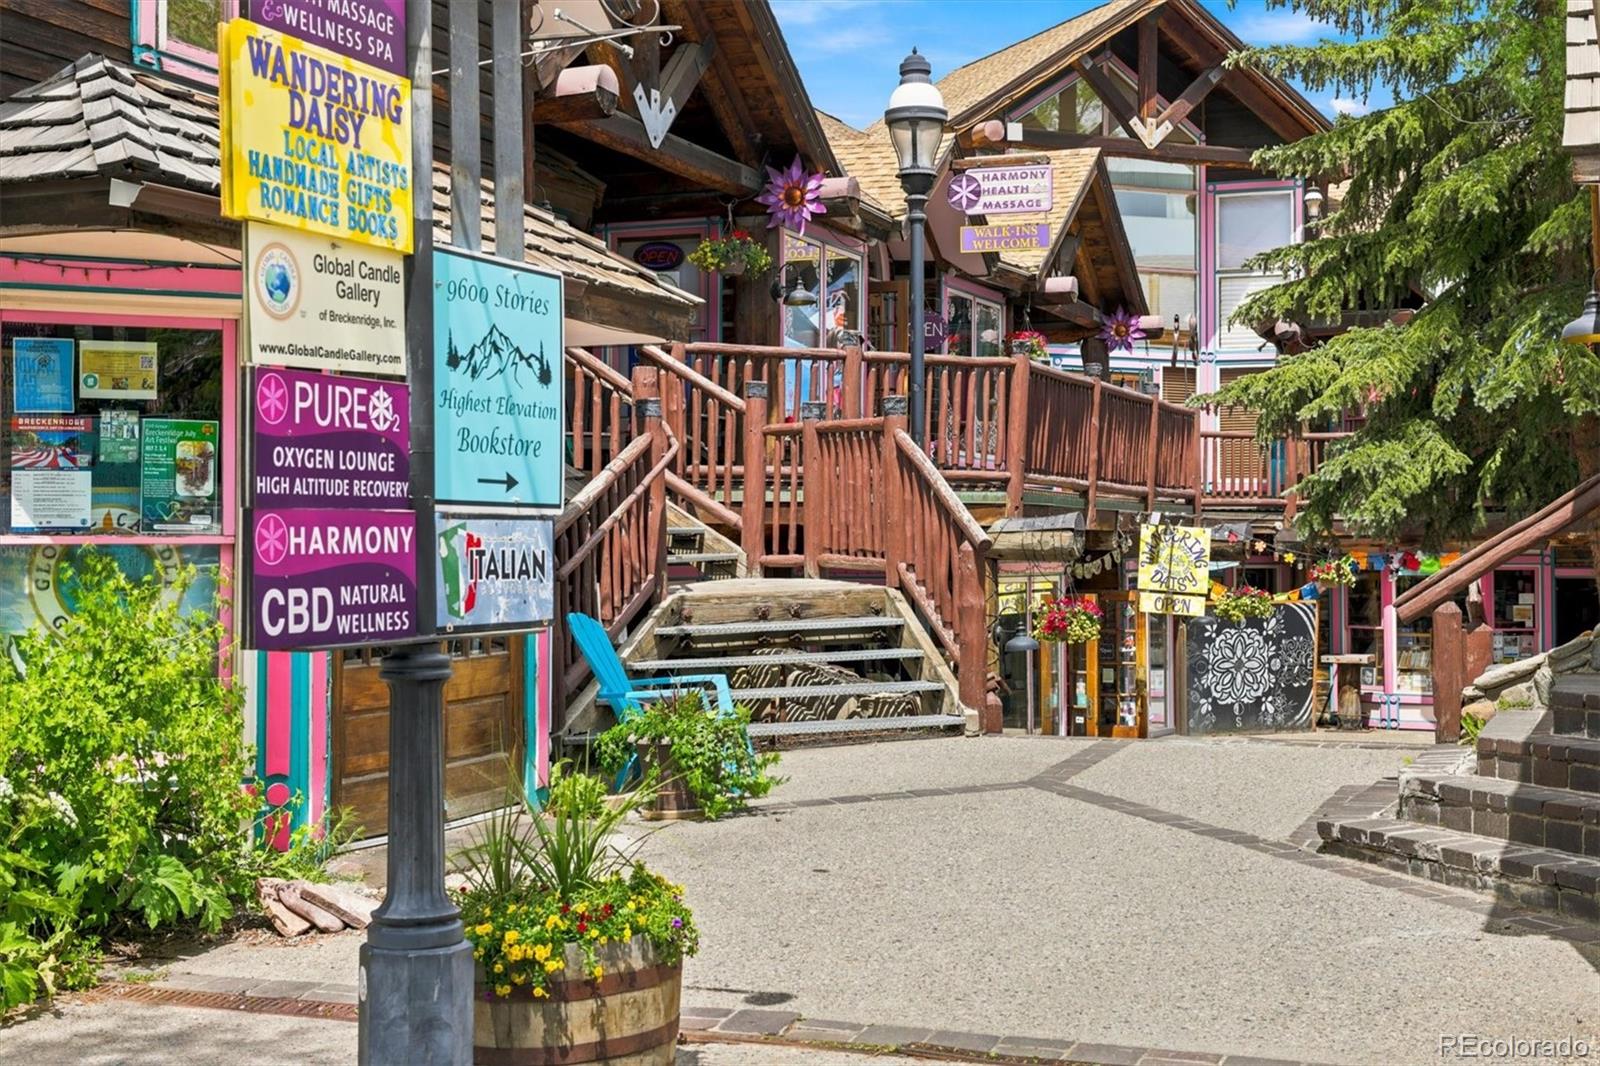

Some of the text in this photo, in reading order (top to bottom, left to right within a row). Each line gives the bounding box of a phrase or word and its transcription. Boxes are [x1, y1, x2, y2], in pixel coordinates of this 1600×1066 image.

[328, 0, 394, 35] MASSAGE
[283, 4, 362, 51] WELLNESS
[368, 36, 393, 62] SPA
[247, 36, 403, 125] WANDERING
[289, 88, 366, 149] DAISY
[284, 130, 408, 190] LOCAL ARTISTS
[248, 150, 393, 213] HANDMADE GIFTS
[983, 171, 1047, 182] HARMONY
[983, 185, 1029, 196] HEALTH
[260, 182, 398, 241] ROMANCE BOOKS
[983, 200, 1042, 210] MASSAGE
[972, 237, 1040, 249] WELCOME
[974, 226, 1038, 237] WALK-INS
[314, 254, 400, 284] Global Candle
[336, 280, 380, 308] Gallery
[447, 278, 549, 316] 9600 Stories
[319, 310, 397, 329] of Breckenridge, Inc.
[259, 343, 401, 365] www.GlobalCandleGallery.com
[439, 388, 557, 420] Highest Elevation
[457, 426, 541, 458] Bookstore
[273, 447, 395, 472] OXYGEN LOUNGE
[257, 476, 409, 498] HIGH ALTITUDE RECOVERY
[290, 526, 413, 555] HARMONY
[469, 549, 547, 583] ITALIAN
[340, 584, 406, 606] NATURAL
[1151, 570, 1198, 592] DAISY
[262, 587, 334, 637] CBD
[1154, 596, 1191, 613] OPEN
[337, 611, 409, 634] WELLNESS
